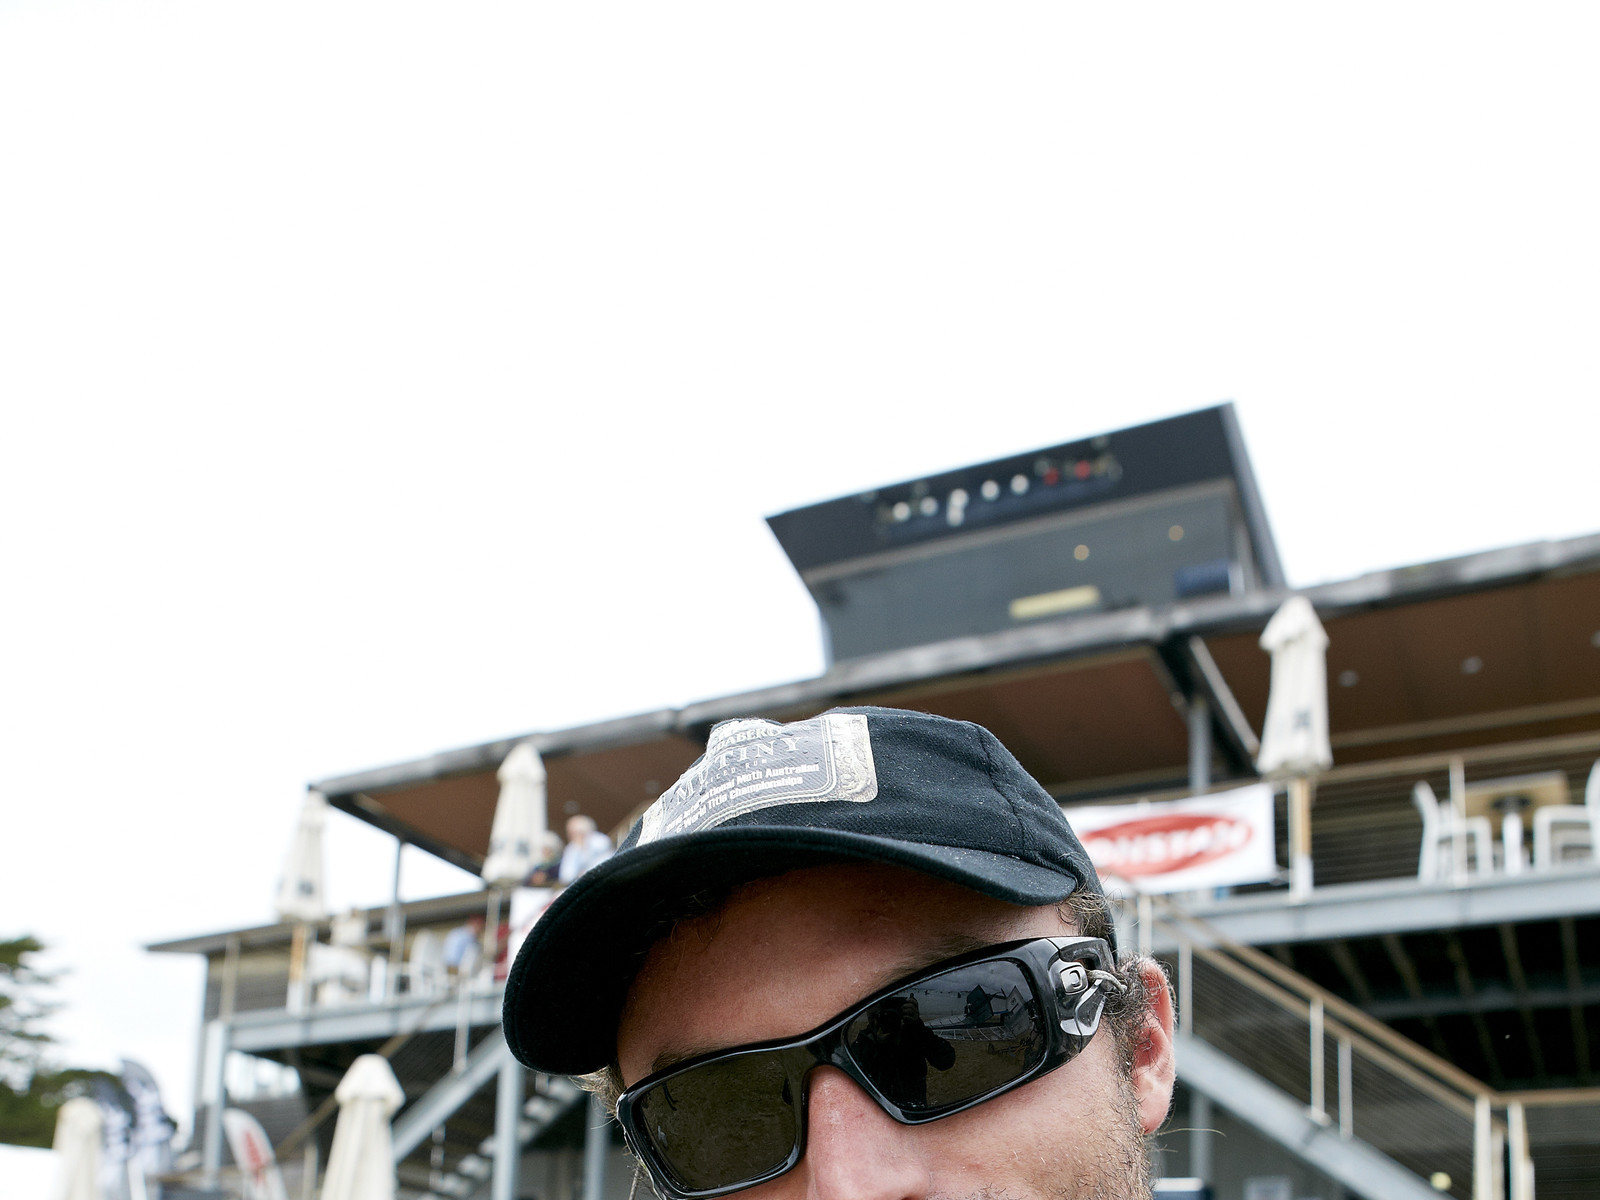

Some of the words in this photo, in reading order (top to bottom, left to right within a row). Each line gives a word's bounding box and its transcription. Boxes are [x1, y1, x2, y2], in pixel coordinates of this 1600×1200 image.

[736, 769, 763, 786] Moth
[765, 763, 820, 778] Australian
[745, 758, 768, 769] RUM
[707, 793, 728, 811] Title
[729, 776, 803, 800] Championships
